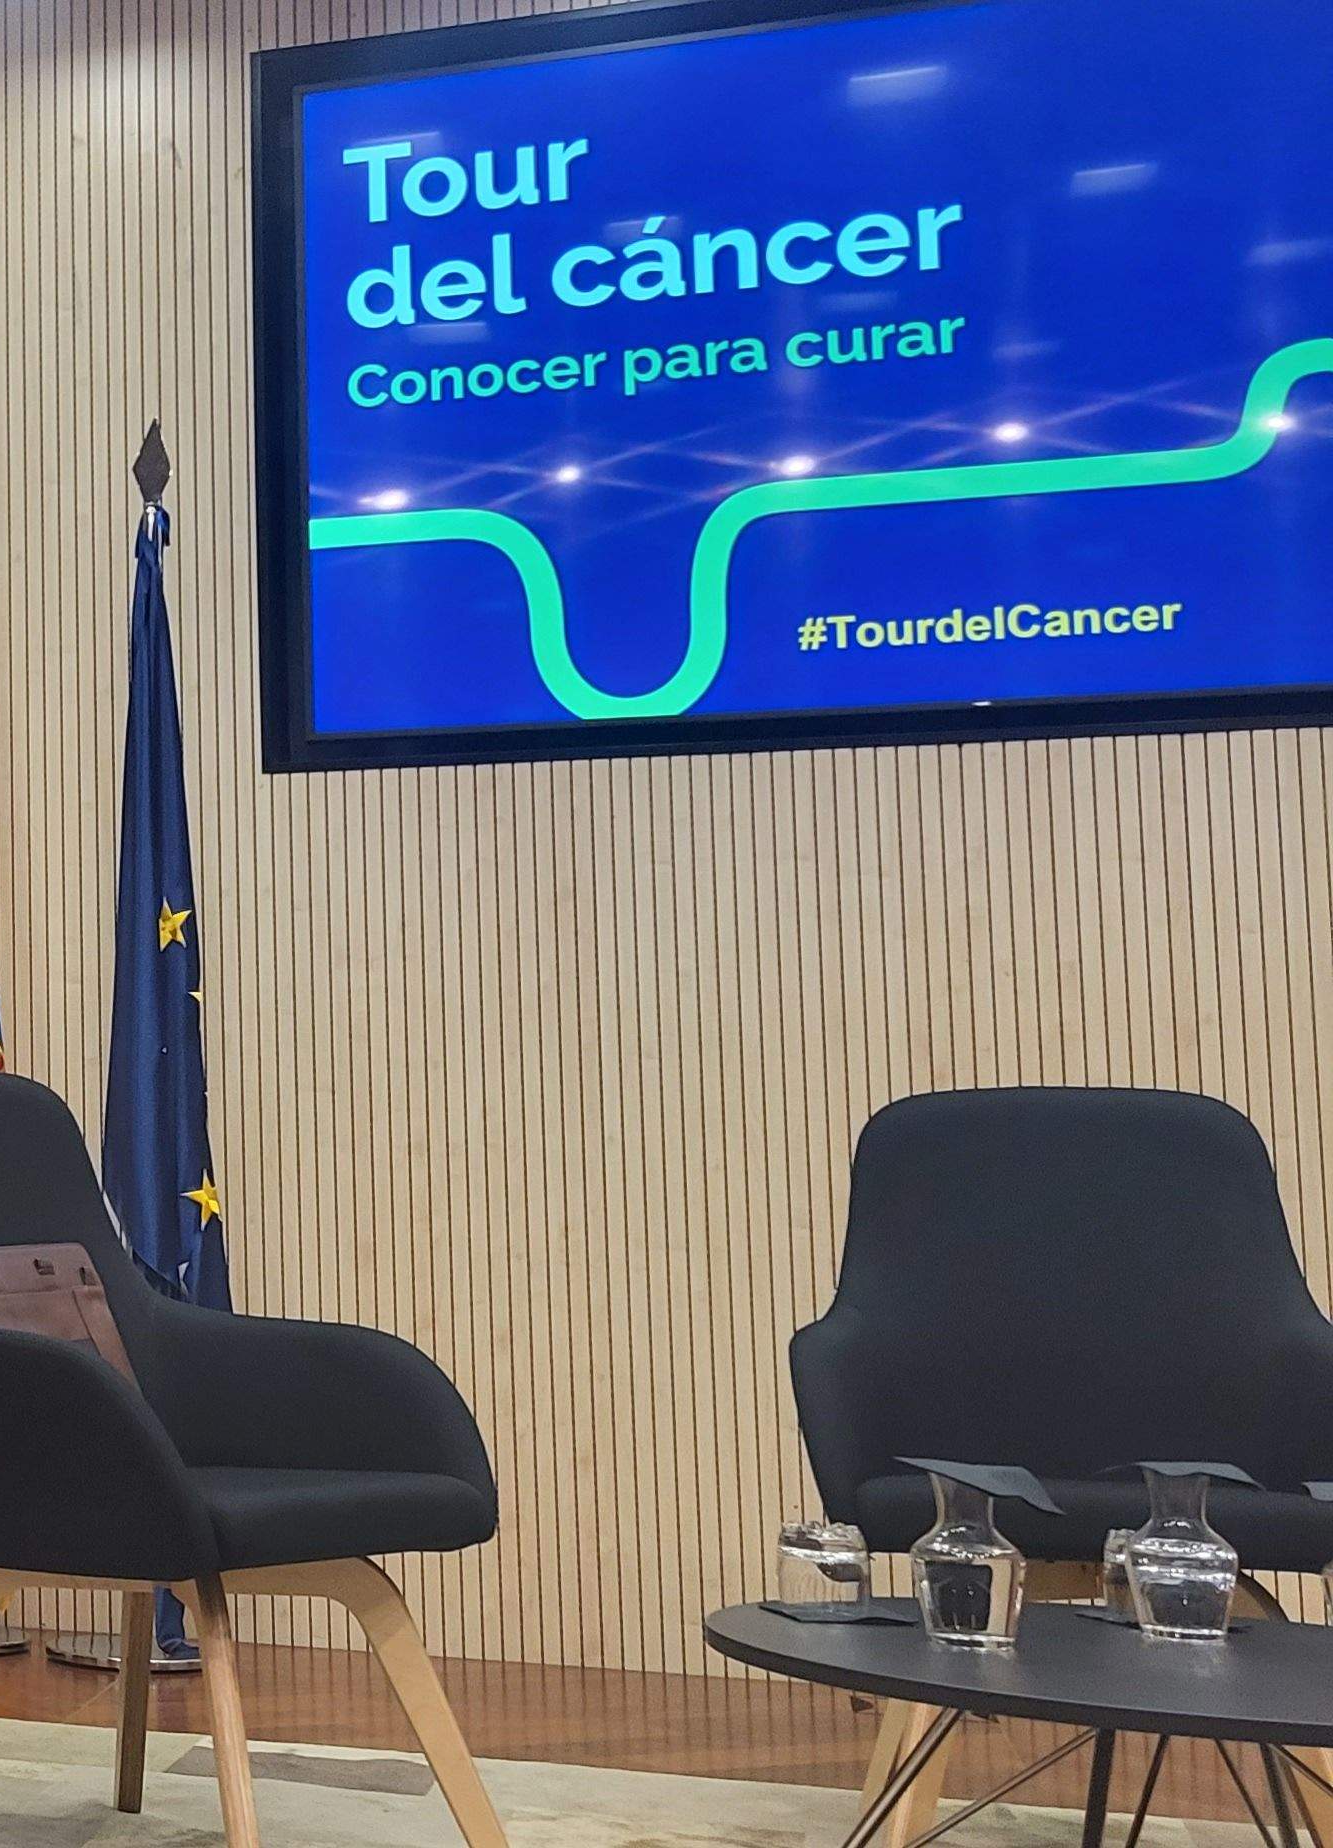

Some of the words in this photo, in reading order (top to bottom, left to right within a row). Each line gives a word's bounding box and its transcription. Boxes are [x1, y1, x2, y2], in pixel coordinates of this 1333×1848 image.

[342, 138, 589, 223] Tour
[346, 233, 527, 329] del
[551, 204, 962, 307] cáncer
[347, 352, 607, 408] Conocer
[623, 336, 768, 396] para
[785, 316, 965, 368] curar
[798, 602, 1182, 651] #TourdelCancer
